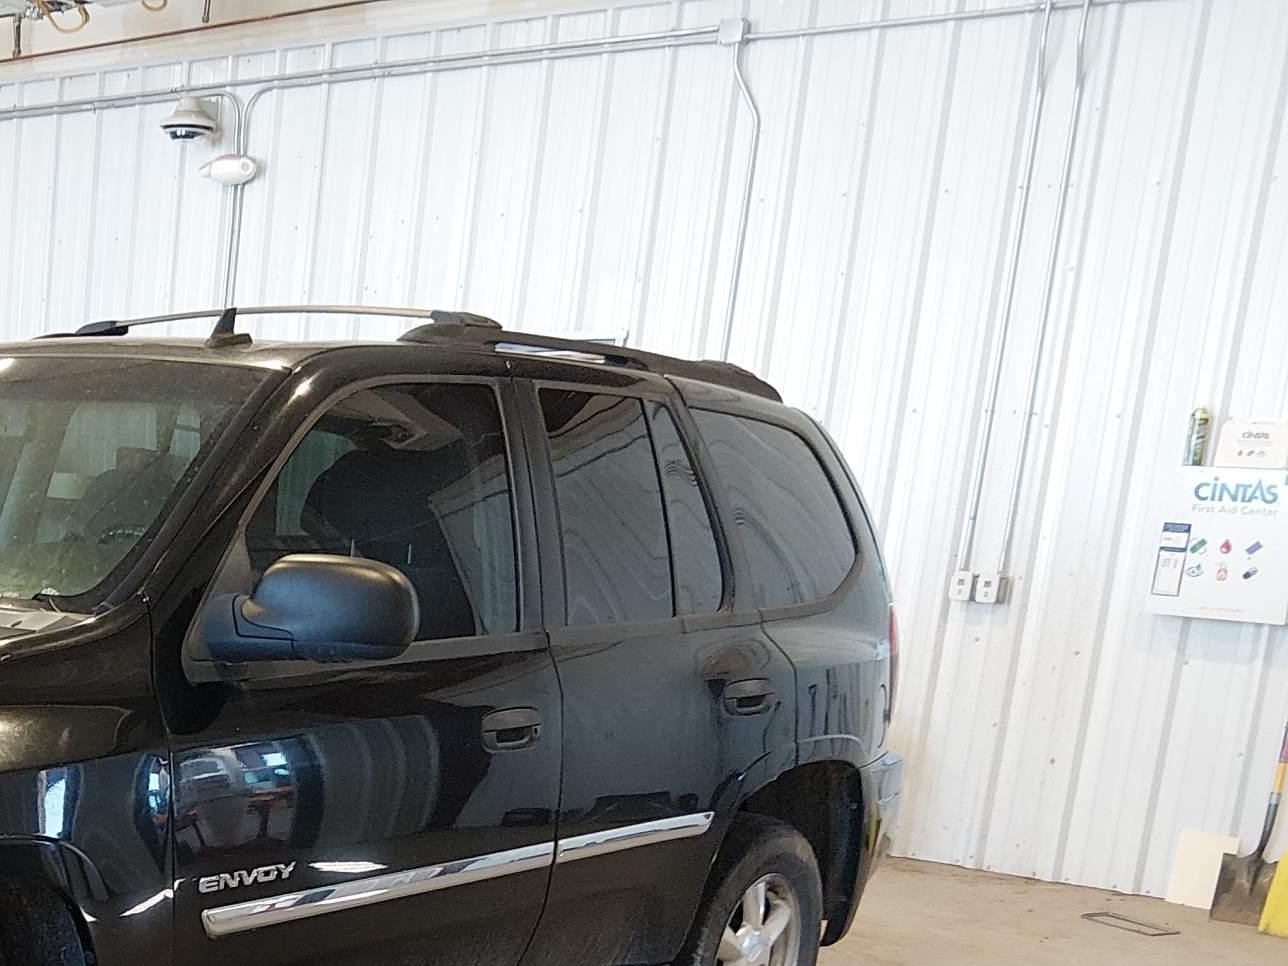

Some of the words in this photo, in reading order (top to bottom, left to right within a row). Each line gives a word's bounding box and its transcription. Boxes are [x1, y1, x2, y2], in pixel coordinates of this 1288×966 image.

[1192, 503, 1215, 513] First
[1218, 504, 1238, 514] Aid
[1240, 505, 1278, 517] Center
[198, 861, 297, 894] ENVOY
